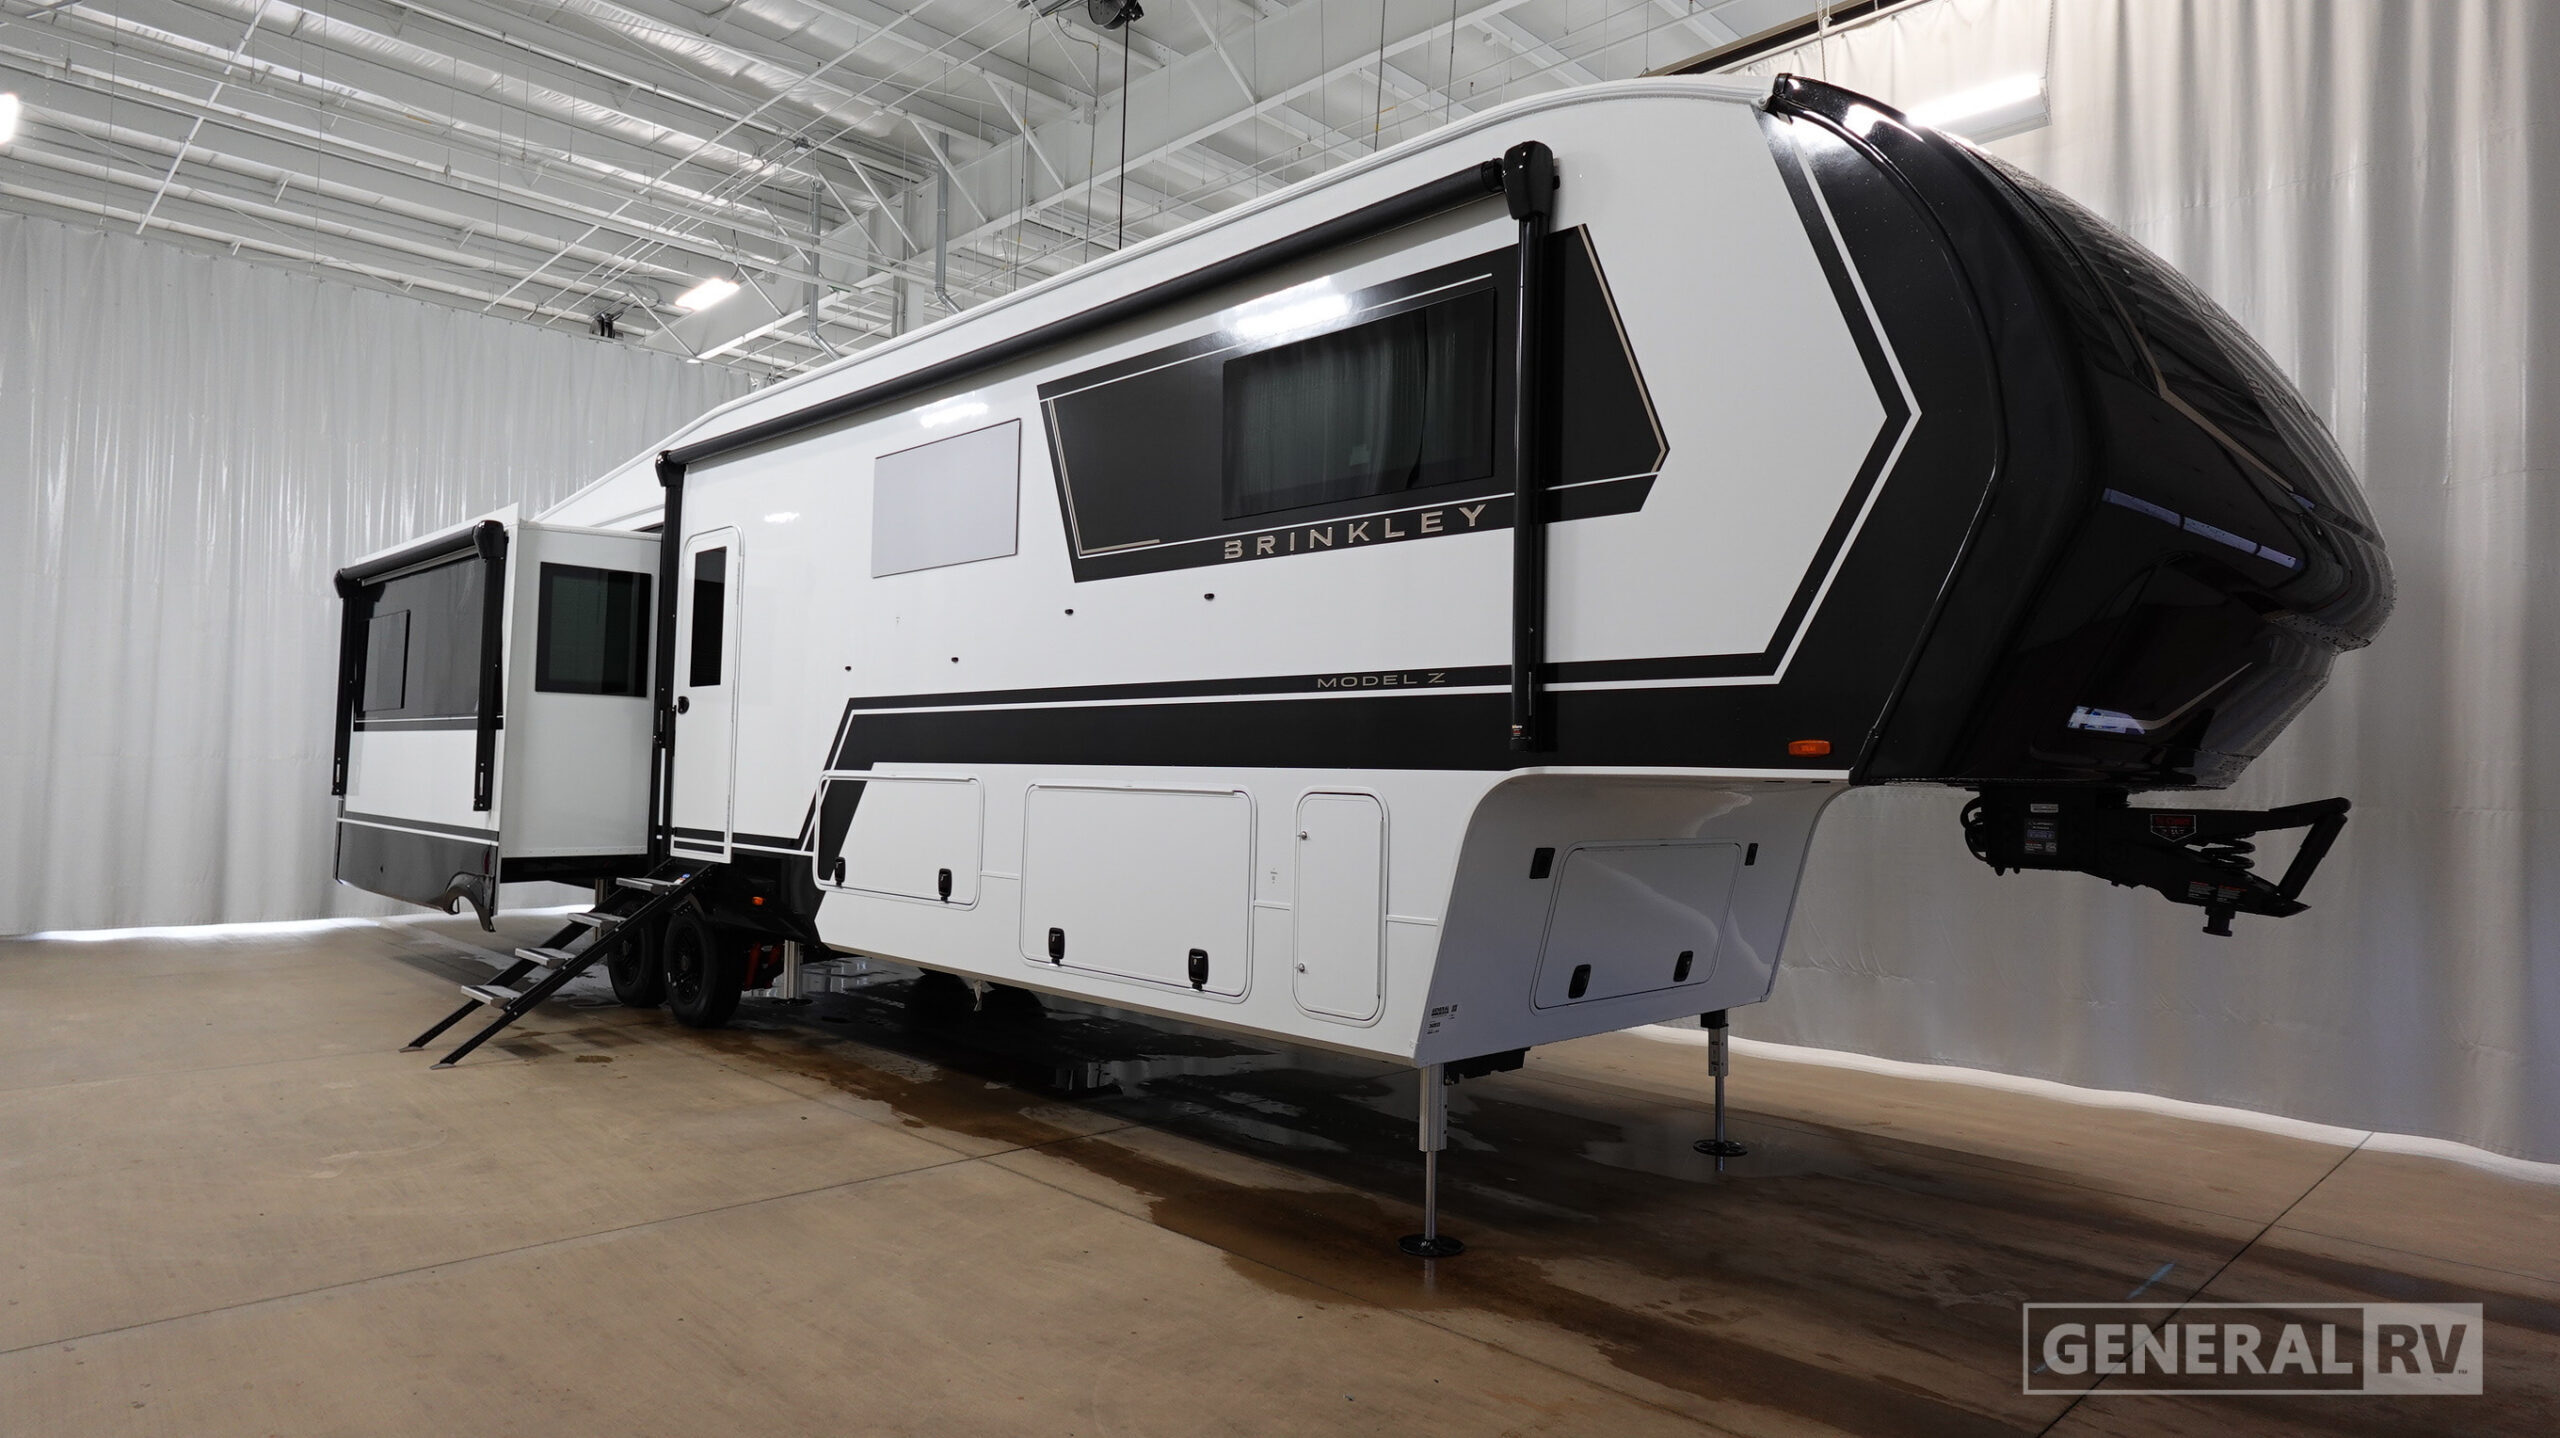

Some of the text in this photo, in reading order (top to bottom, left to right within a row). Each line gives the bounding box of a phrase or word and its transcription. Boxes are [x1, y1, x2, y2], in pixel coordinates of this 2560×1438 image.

[1225, 504, 1487, 559] BRINKLEY
[1317, 672, 1446, 688] MODEL Z
